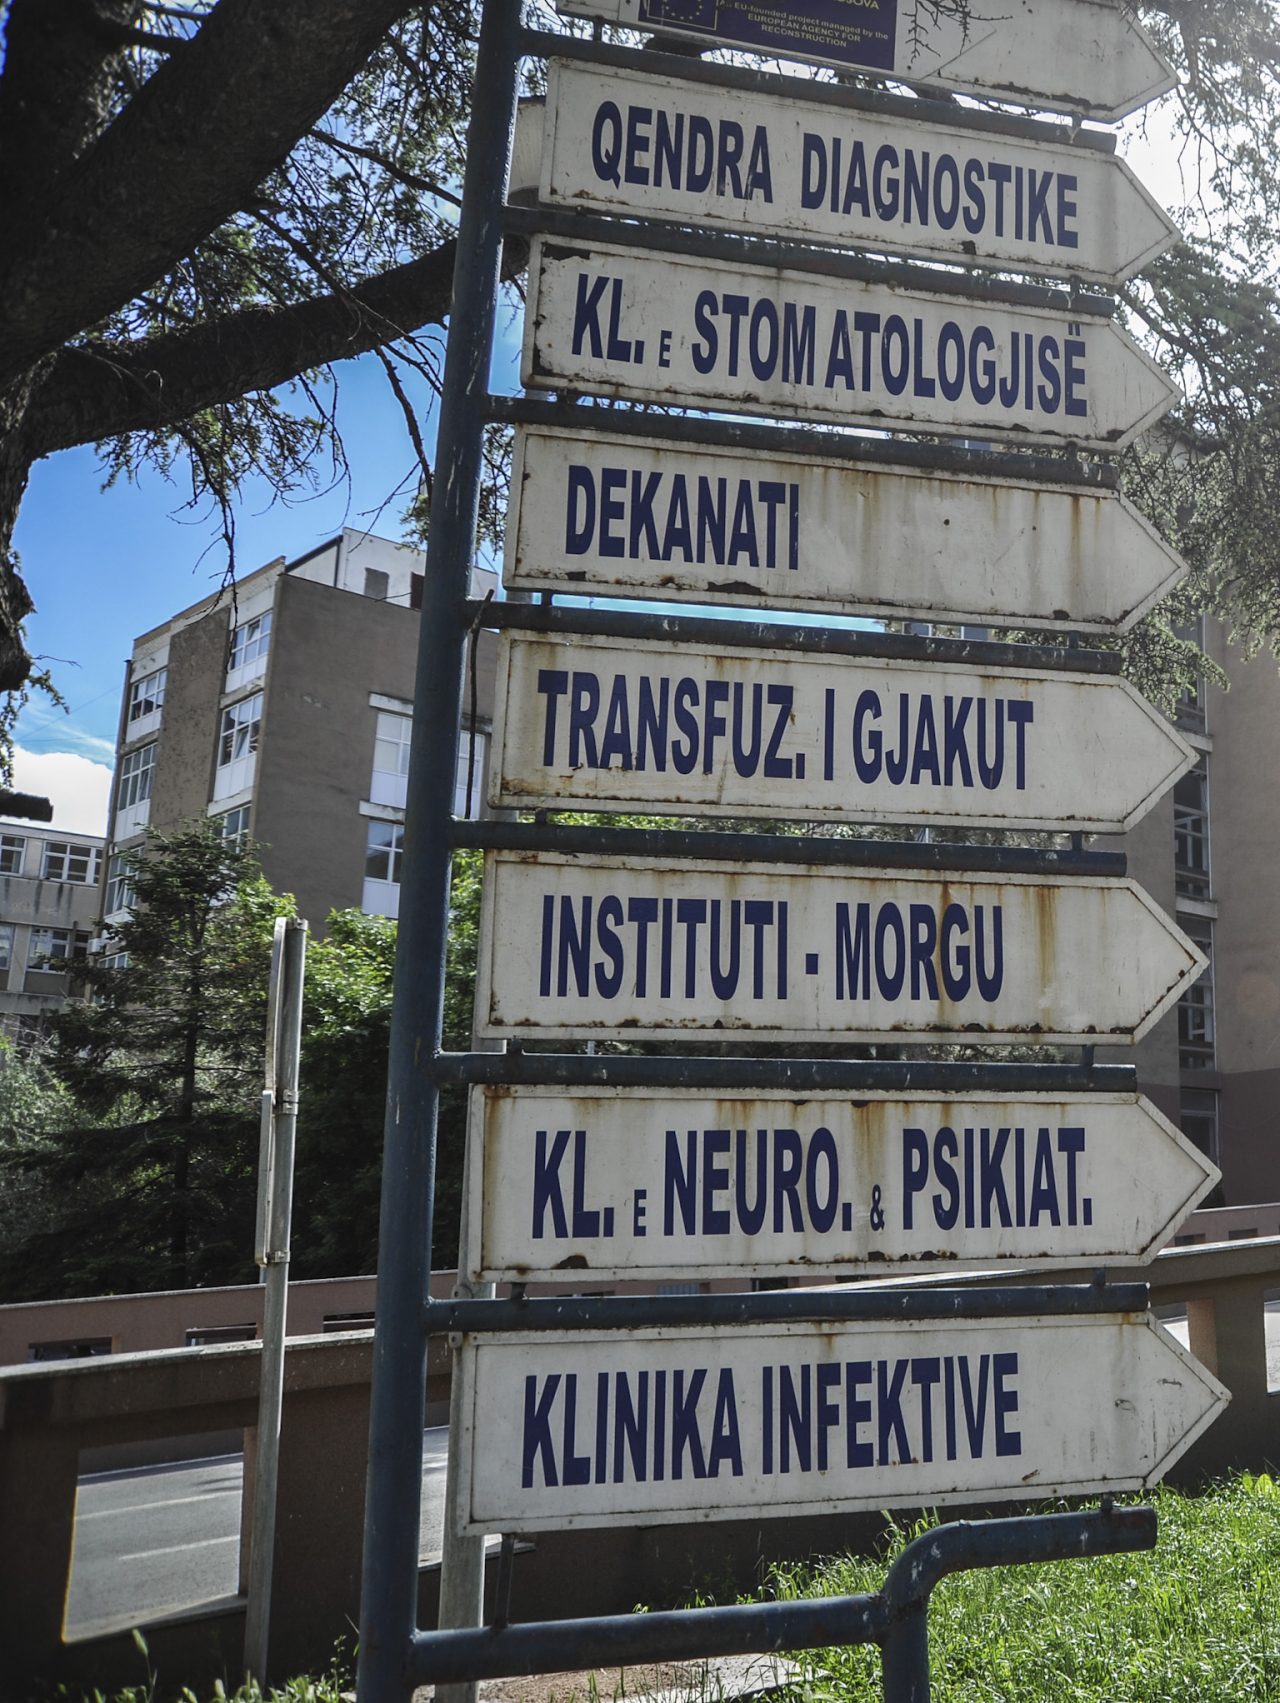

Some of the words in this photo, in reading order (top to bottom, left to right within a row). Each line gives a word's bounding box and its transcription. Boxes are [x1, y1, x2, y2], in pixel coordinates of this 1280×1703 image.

[747, 13, 800, 29] EUROPEAN
[801, 24, 840, 38] AGENCY
[841, 32, 861, 42] FOR
[761, 24, 847, 47] RECONSTRUCTION
[788, 14, 819, 26] project
[821, 21, 861, 34] managed
[862, 29, 874, 38] by
[875, 32, 889, 40] the
[591, 100, 774, 203] QENDRA
[800, 132, 1080, 249] DIAGNOSTIKE
[571, 273, 645, 364] KL.
[658, 329, 672, 369] E
[565, 464, 800, 571] DEKANATI
[537, 669, 805, 780] TRANSFUZ.
[823, 688, 835, 781] I
[853, 688, 1035, 791] GJAKUT
[539, 894, 789, 1001] INSTITUTI
[835, 901, 1004, 1003] MORGU
[531, 1130, 615, 1239] KL.
[633, 1189, 647, 1237] E
[663, 1126, 853, 1237] NEURO.
[869, 1184, 885, 1232] &
[902, 1127, 1093, 1231] PSIKIAT.
[521, 1367, 743, 1489] KLINIKA
[762, 1352, 1022, 1474] INFEKTIVE
